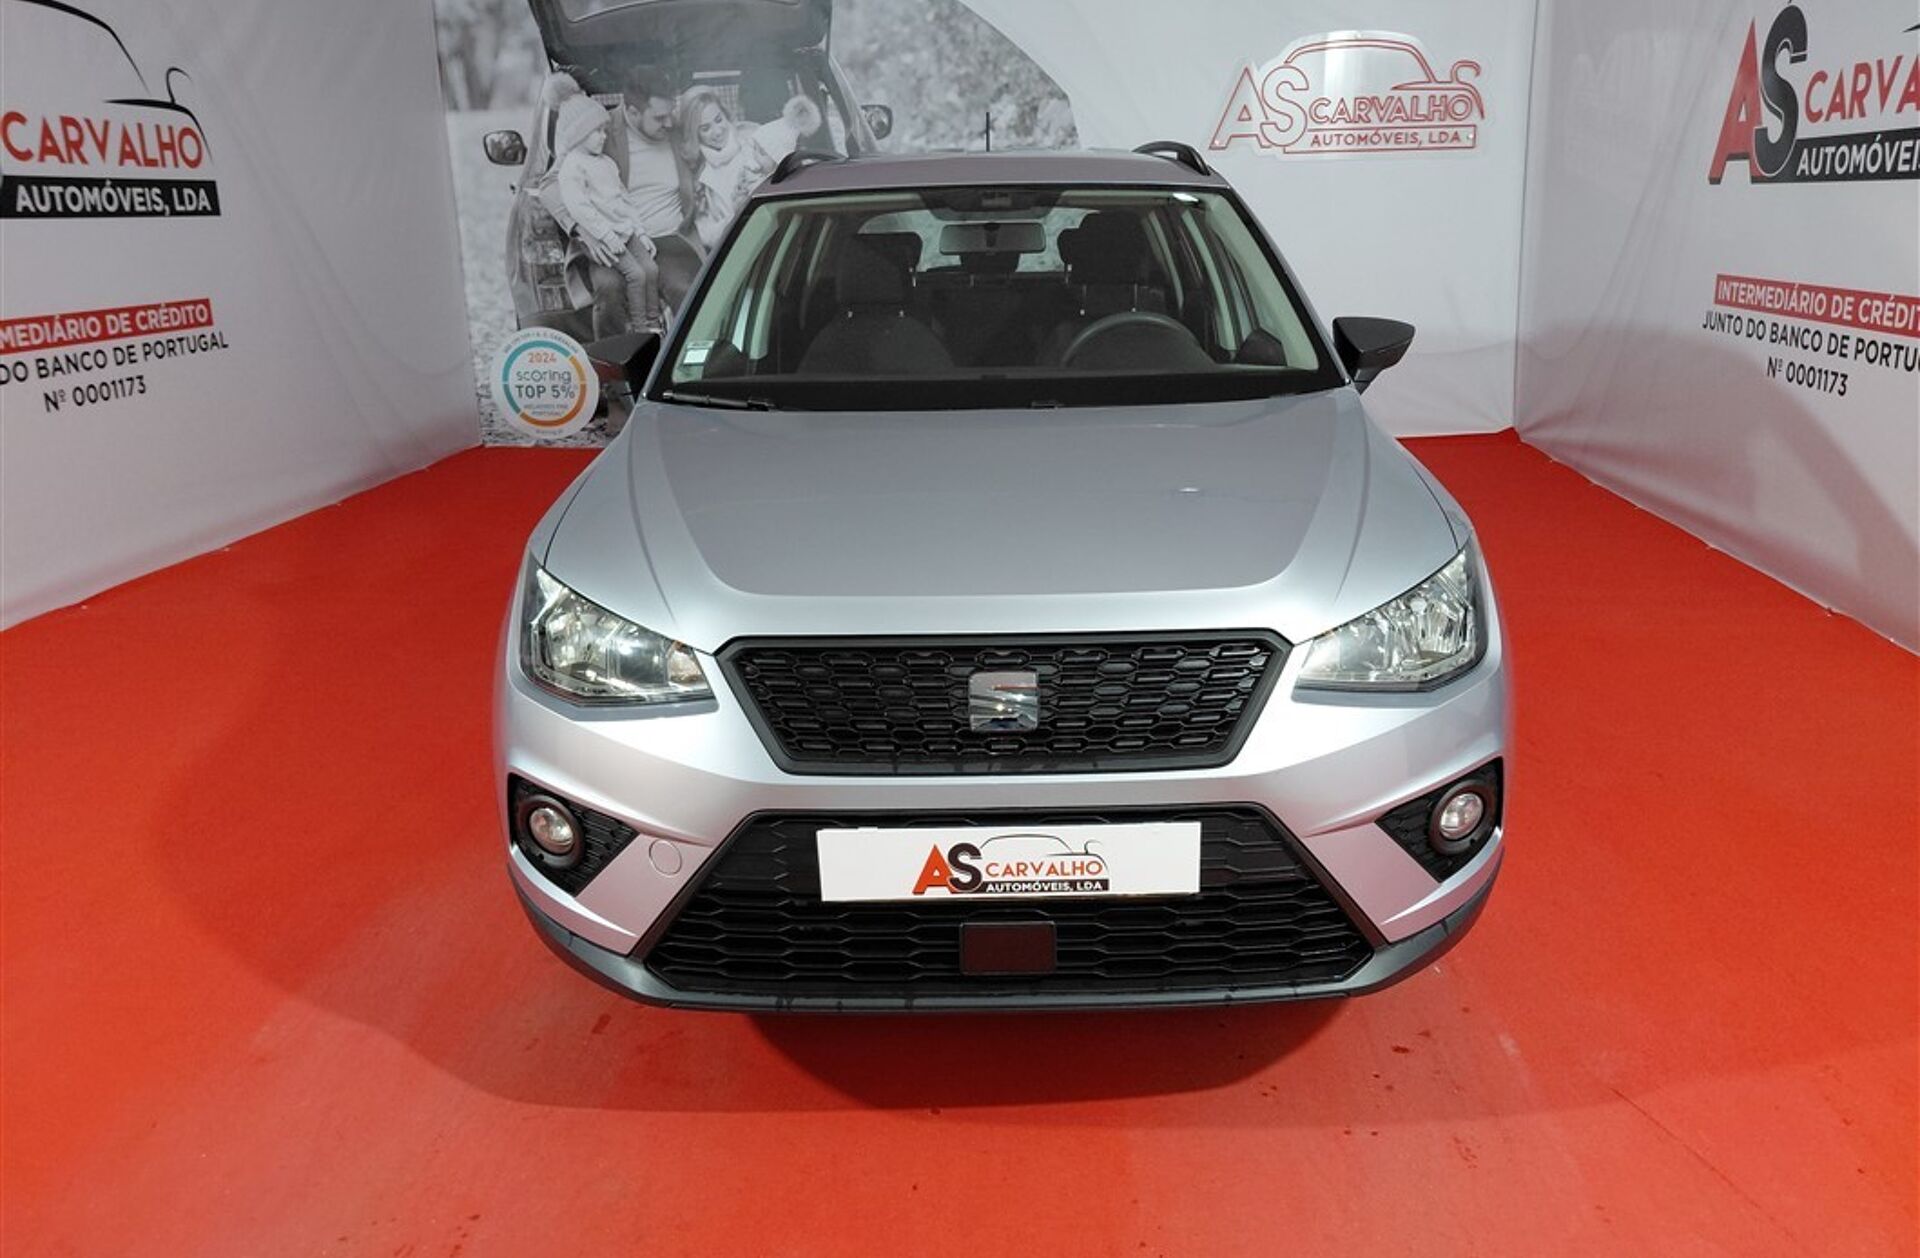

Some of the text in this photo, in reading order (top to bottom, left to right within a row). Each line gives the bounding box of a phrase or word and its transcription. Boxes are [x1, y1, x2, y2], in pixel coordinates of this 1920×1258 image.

[1209, 65, 1474, 149] AS CARVALHO
[1709, 5, 1808, 185] AS
[0, 111, 202, 169] CARVALHO
[1311, 129, 1462, 147] AUTOMÓVEIS, LDA
[1796, 134, 1920, 176] AUTOMÓVEI
[16, 179, 212, 216] AUTOMÓVEIS, LDA
[106, 313, 133, 335] DE
[136, 302, 209, 330] CRÉDITO
[1717, 281, 1827, 316] INTERMEDIÁRIO
[1831, 295, 1855, 321] DE
[35, 349, 108, 379] BANCO
[113, 345, 138, 366] DE
[143, 331, 229, 361] PORTUGAL
[528, 352, 556, 363] 2024
[1702, 311, 1920, 372] JUNTO DO BANCO DE PORTU
[43, 375, 146, 412] Nº 0001173
[515, 385, 575, 399] TOP 5%
[516, 370, 572, 385] scoring
[1766, 356, 1848, 396] Nº 0001173
[912, 842, 1103, 895] AS CARVALHO
[986, 880, 1103, 892] AUTOMÓVEIS, LDA
